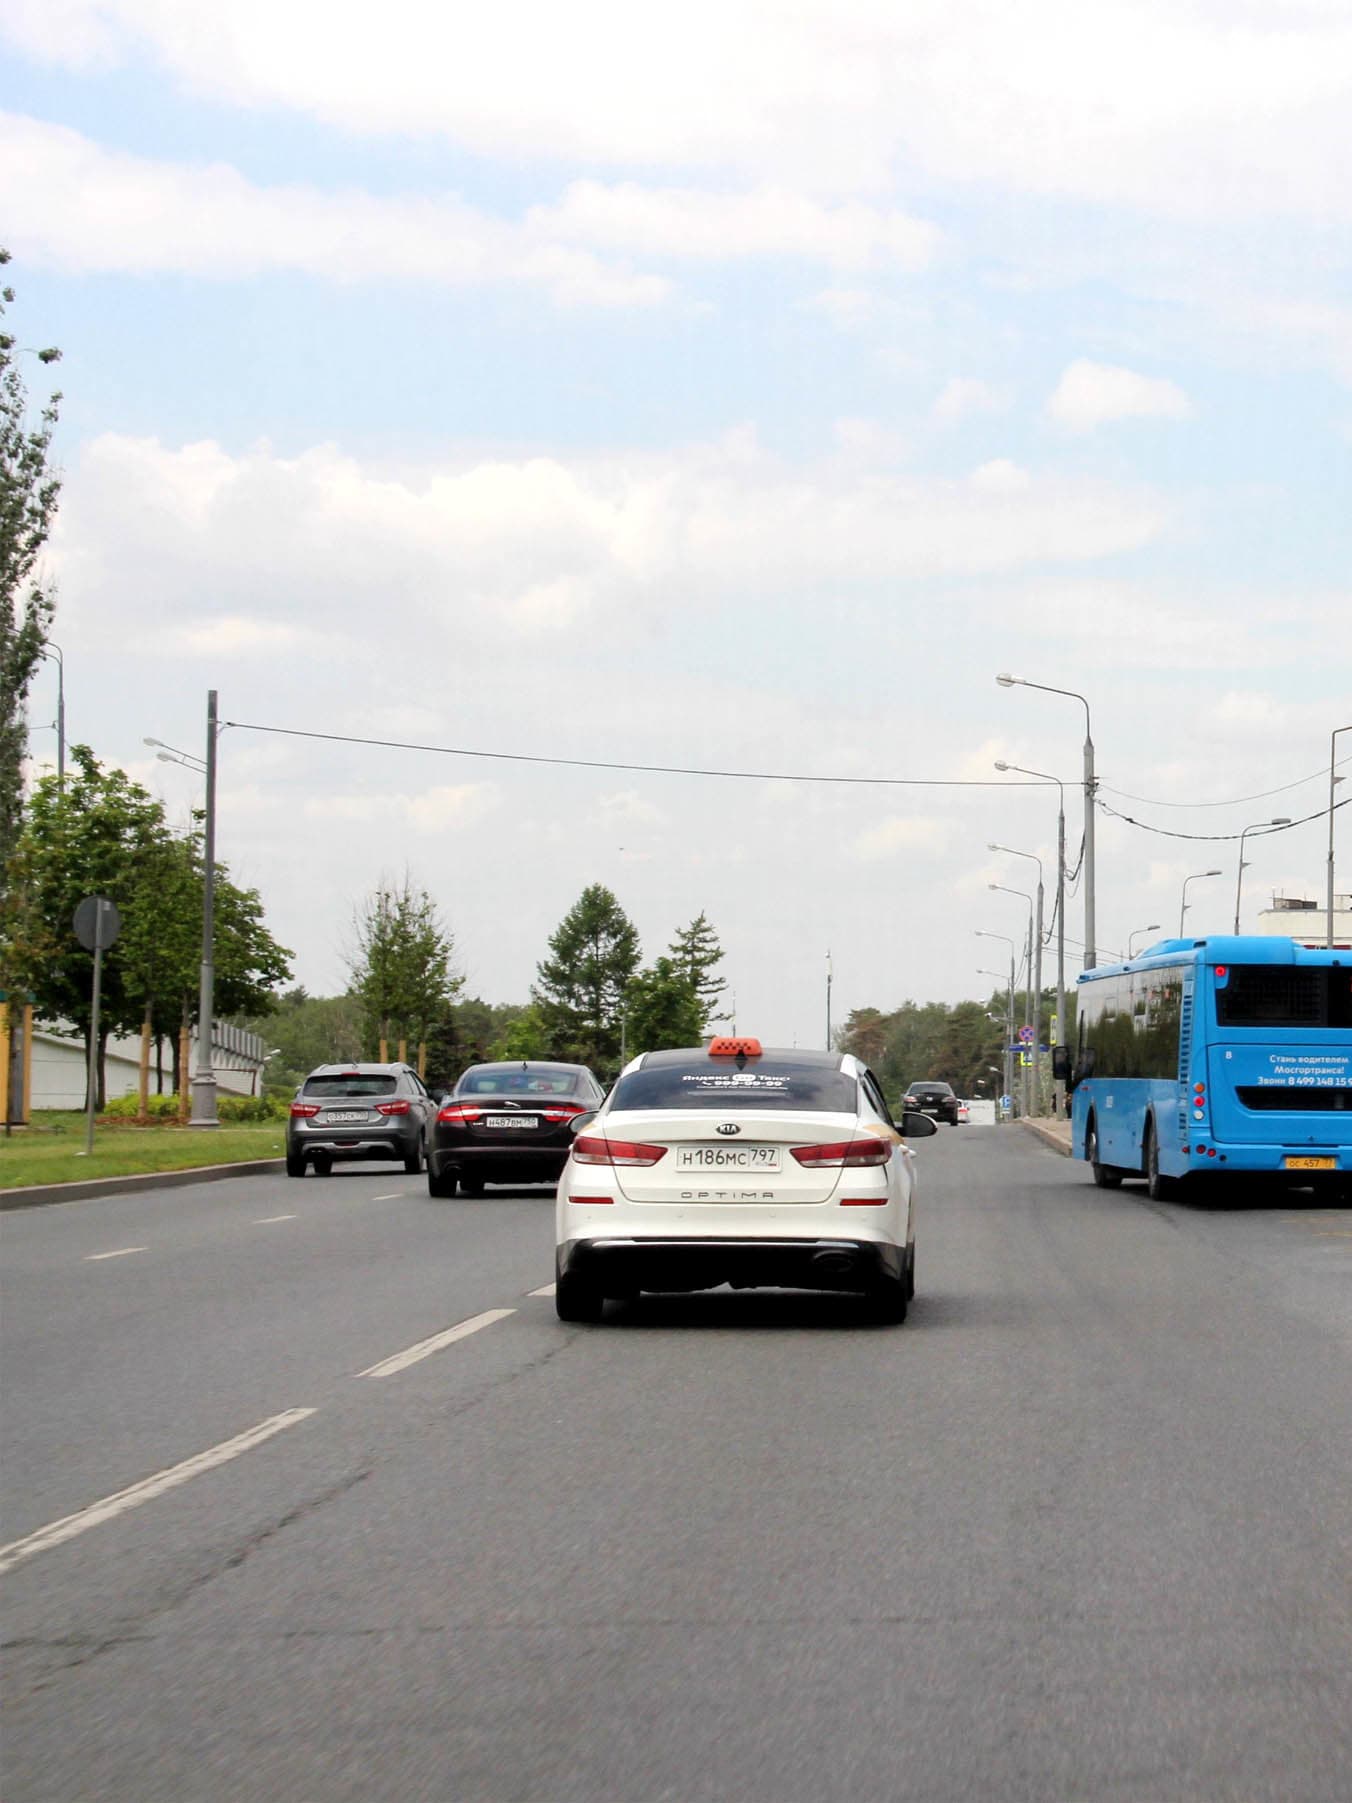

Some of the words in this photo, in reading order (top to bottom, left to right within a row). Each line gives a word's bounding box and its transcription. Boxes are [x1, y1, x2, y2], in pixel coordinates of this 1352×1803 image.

[1269, 1054, 1297, 1064] Стань
[1299, 1056, 1349, 1065] водителем
[1288, 1077, 1295, 1086] 8
[1296, 1077, 1315, 1086] 499
[1336, 1077, 1346, 1087] 15
[719, 1124, 738, 1134] KIA
[681, 1191, 774, 1199] OPTIMA
